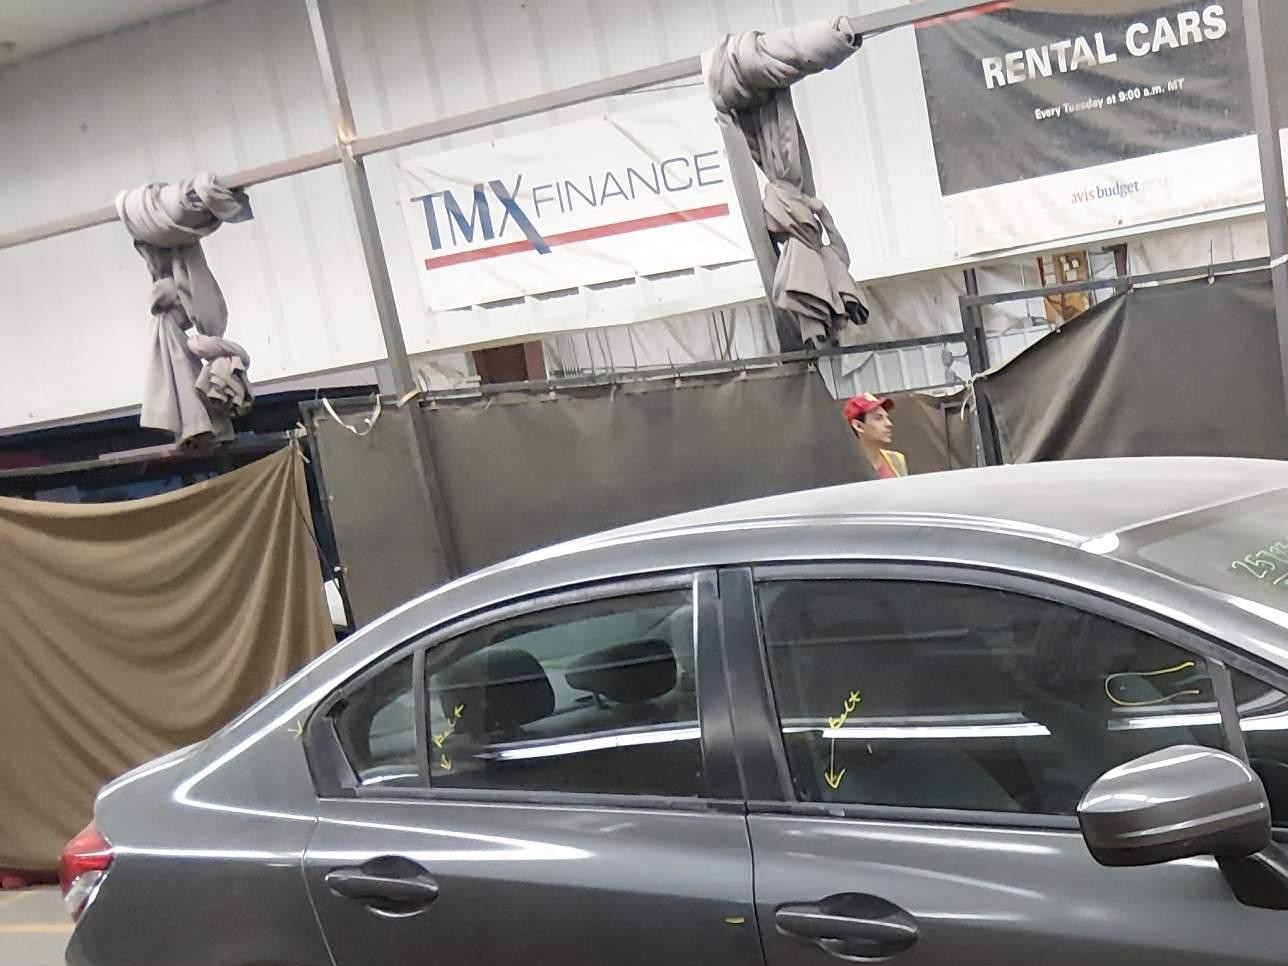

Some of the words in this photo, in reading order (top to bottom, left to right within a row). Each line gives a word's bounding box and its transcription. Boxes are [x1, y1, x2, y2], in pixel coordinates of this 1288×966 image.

[982, 32, 1118, 89] RENTAL
[1126, 5, 1227, 58] CARS
[1034, 107, 1061, 120] Every
[1063, 97, 1104, 114] Tuesday
[1106, 94, 1117, 106] at
[1143, 84, 1166, 98] a.m.
[1167, 78, 1185, 92] MT
[410, 173, 552, 255] TMX
[531, 150, 724, 219] FINANCE
[1071, 187, 1096, 205] avis
[1096, 180, 1140, 199] budget
